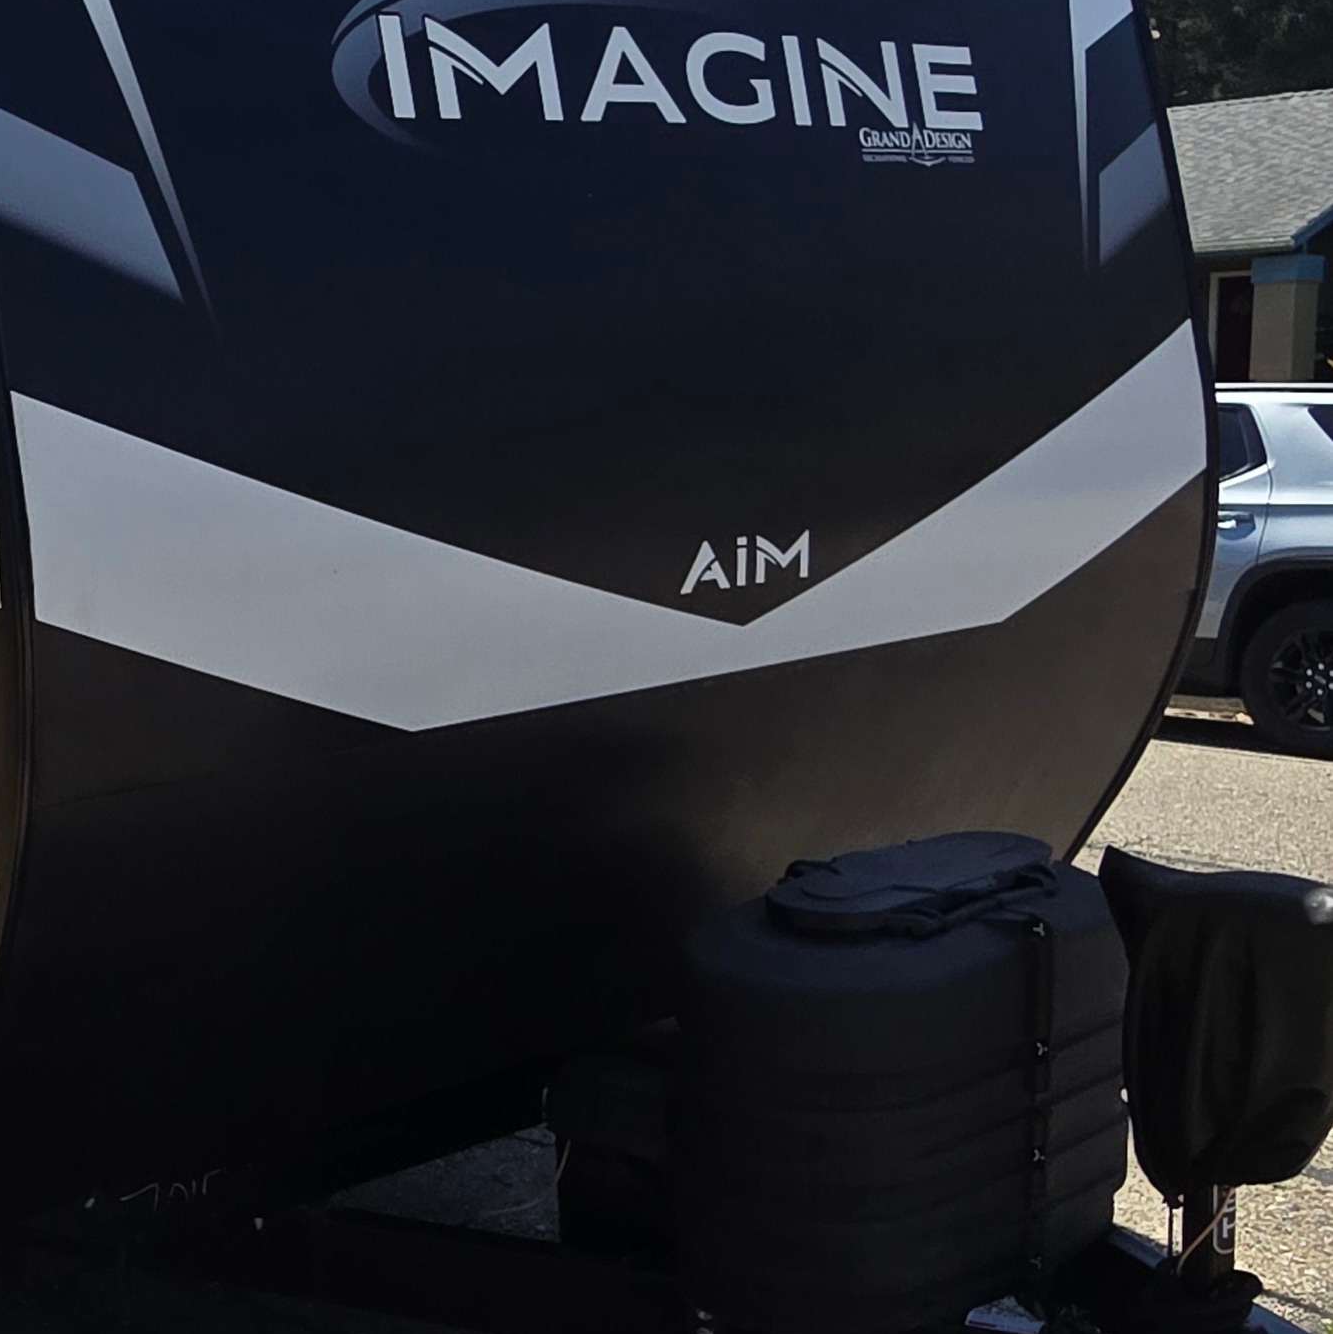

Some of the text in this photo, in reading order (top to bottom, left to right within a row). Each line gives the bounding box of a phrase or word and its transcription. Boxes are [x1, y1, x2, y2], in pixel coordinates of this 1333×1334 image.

[377, 13, 983, 131] IMAGINE
[859, 127, 972, 148] GRAND DESIGN
